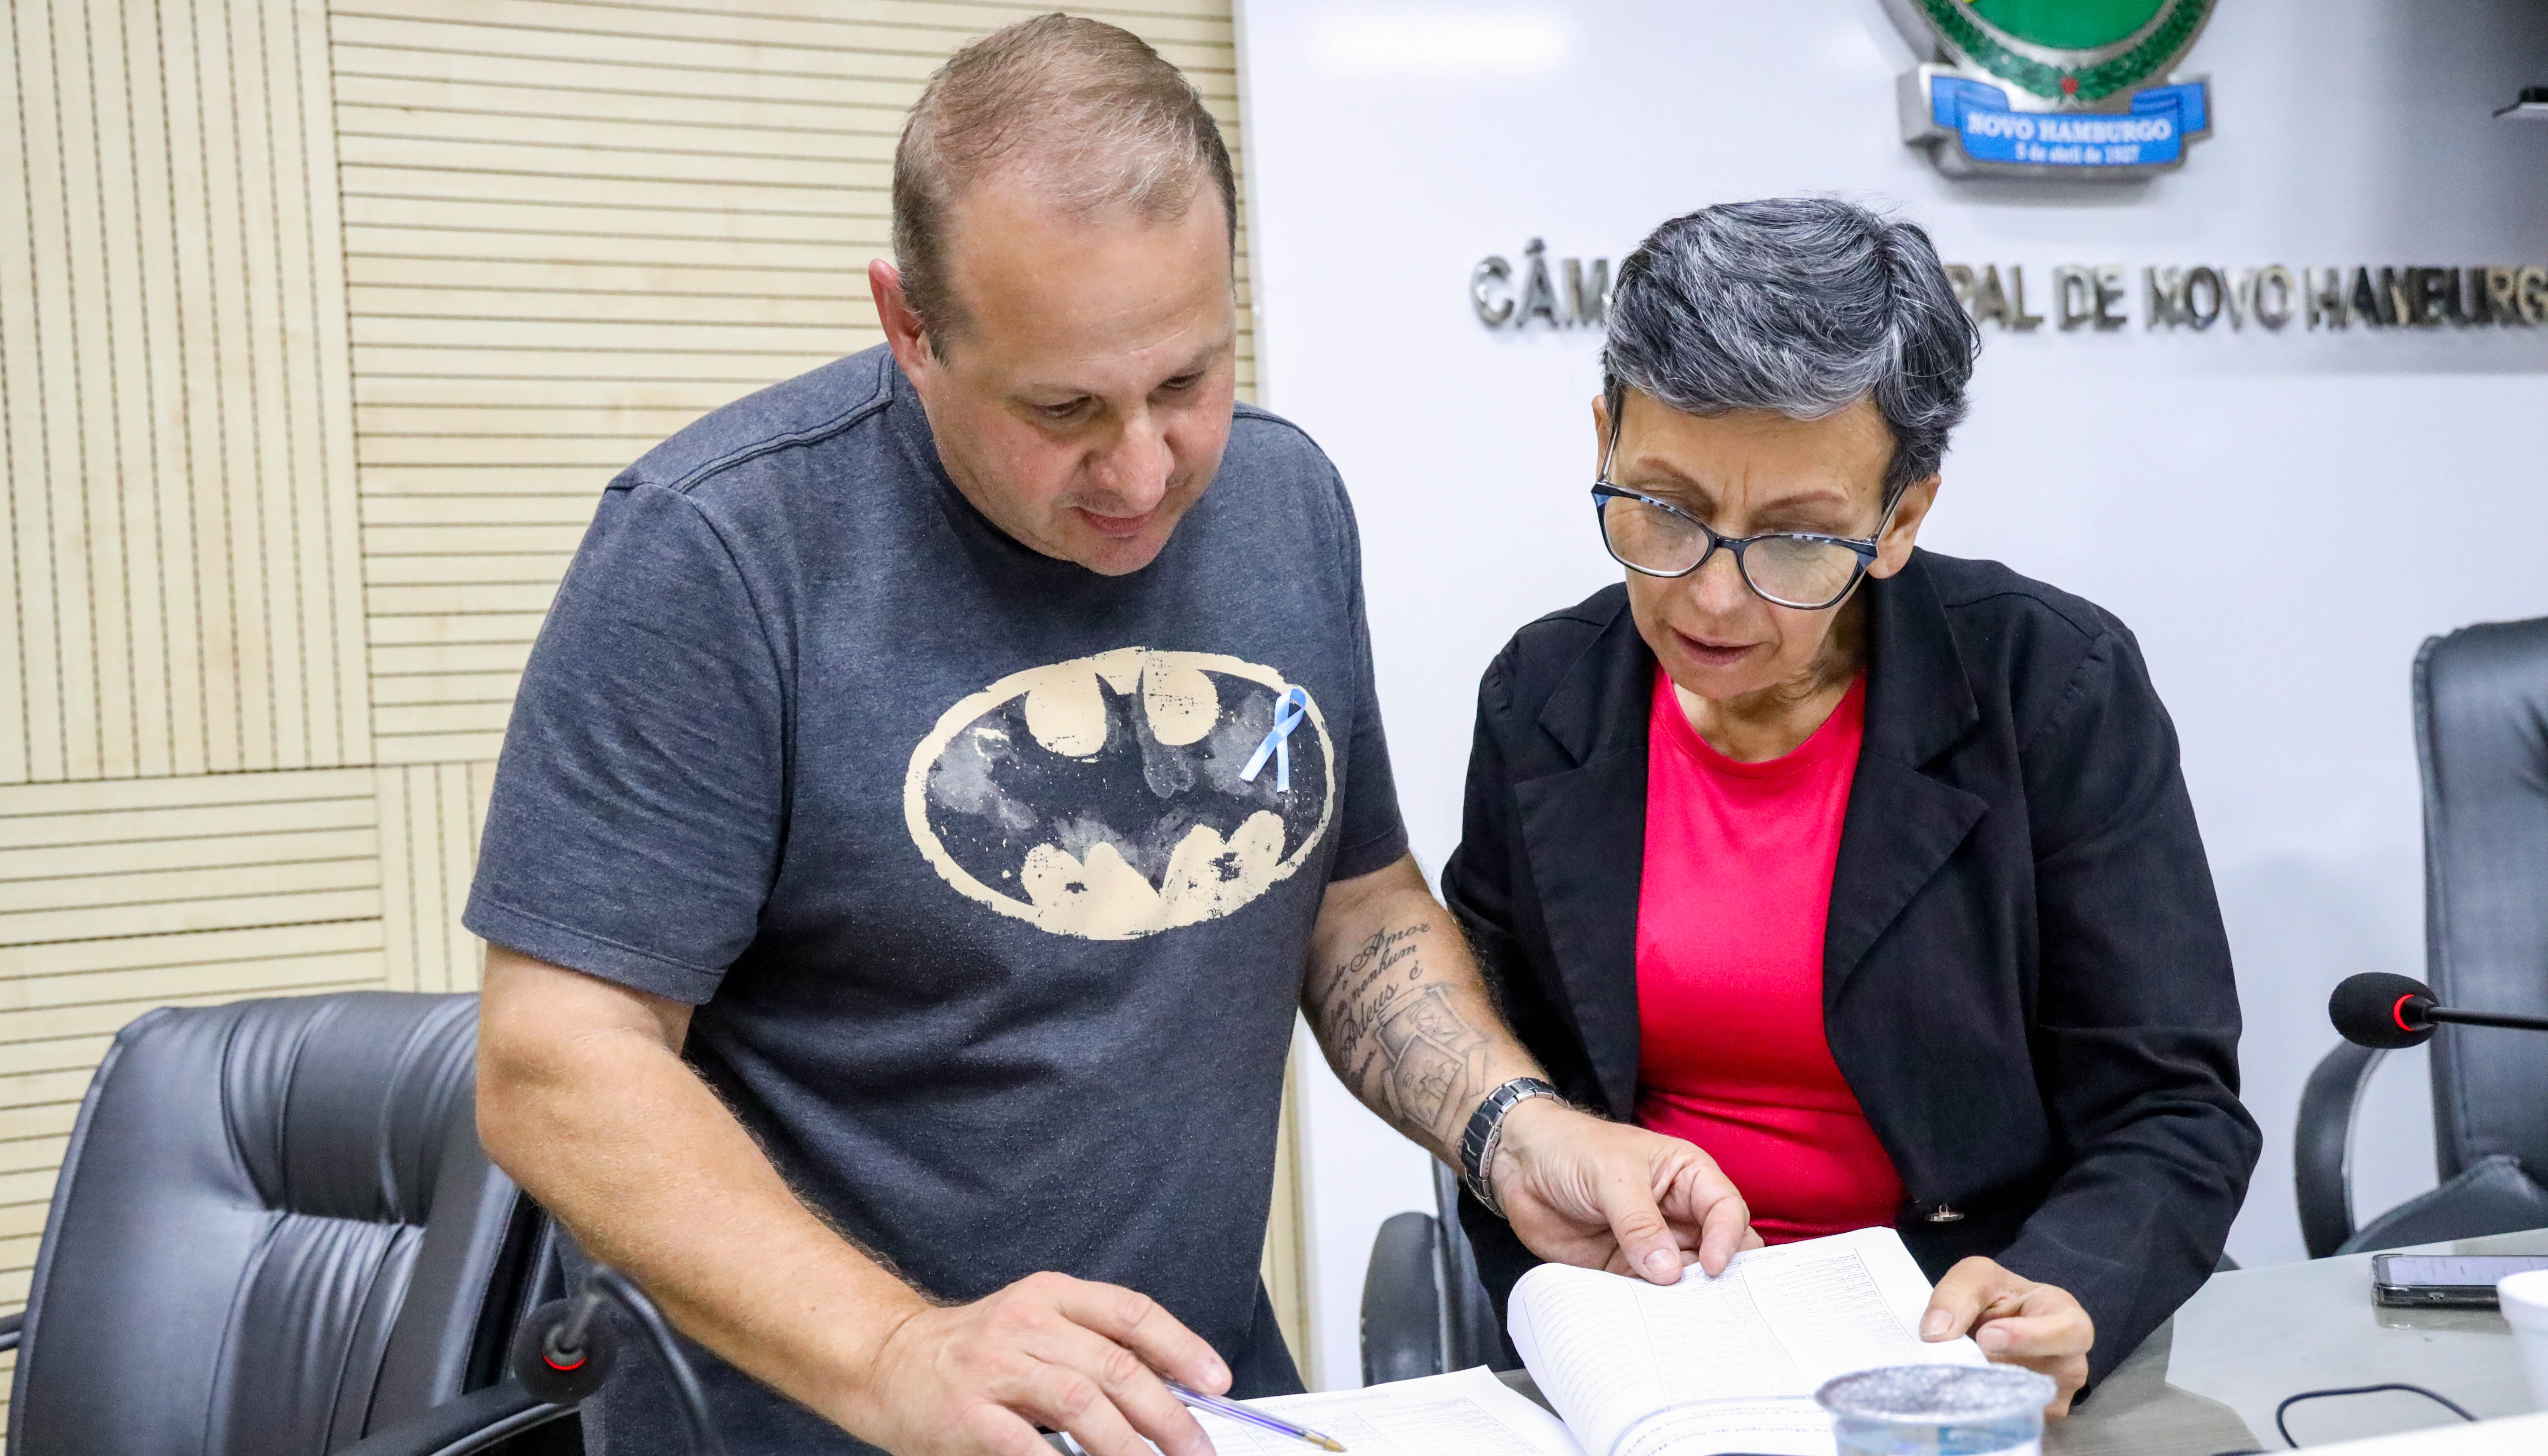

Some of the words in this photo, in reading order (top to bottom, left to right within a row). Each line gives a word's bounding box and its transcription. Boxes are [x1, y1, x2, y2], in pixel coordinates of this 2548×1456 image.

[1968, 113, 2035, 140] NOVO
[2040, 118, 2171, 142] HAMBURGO
[1470, 237, 1612, 328] CÂM
[2053, 264, 2126, 331] DE
[2142, 265, 2294, 331] NOVO
[2303, 265, 2548, 328] HAMBURG
[1350, 923, 1431, 972] Amor
[1409, 960, 1423, 981] é
[1352, 945, 1417, 1003] nenhum
